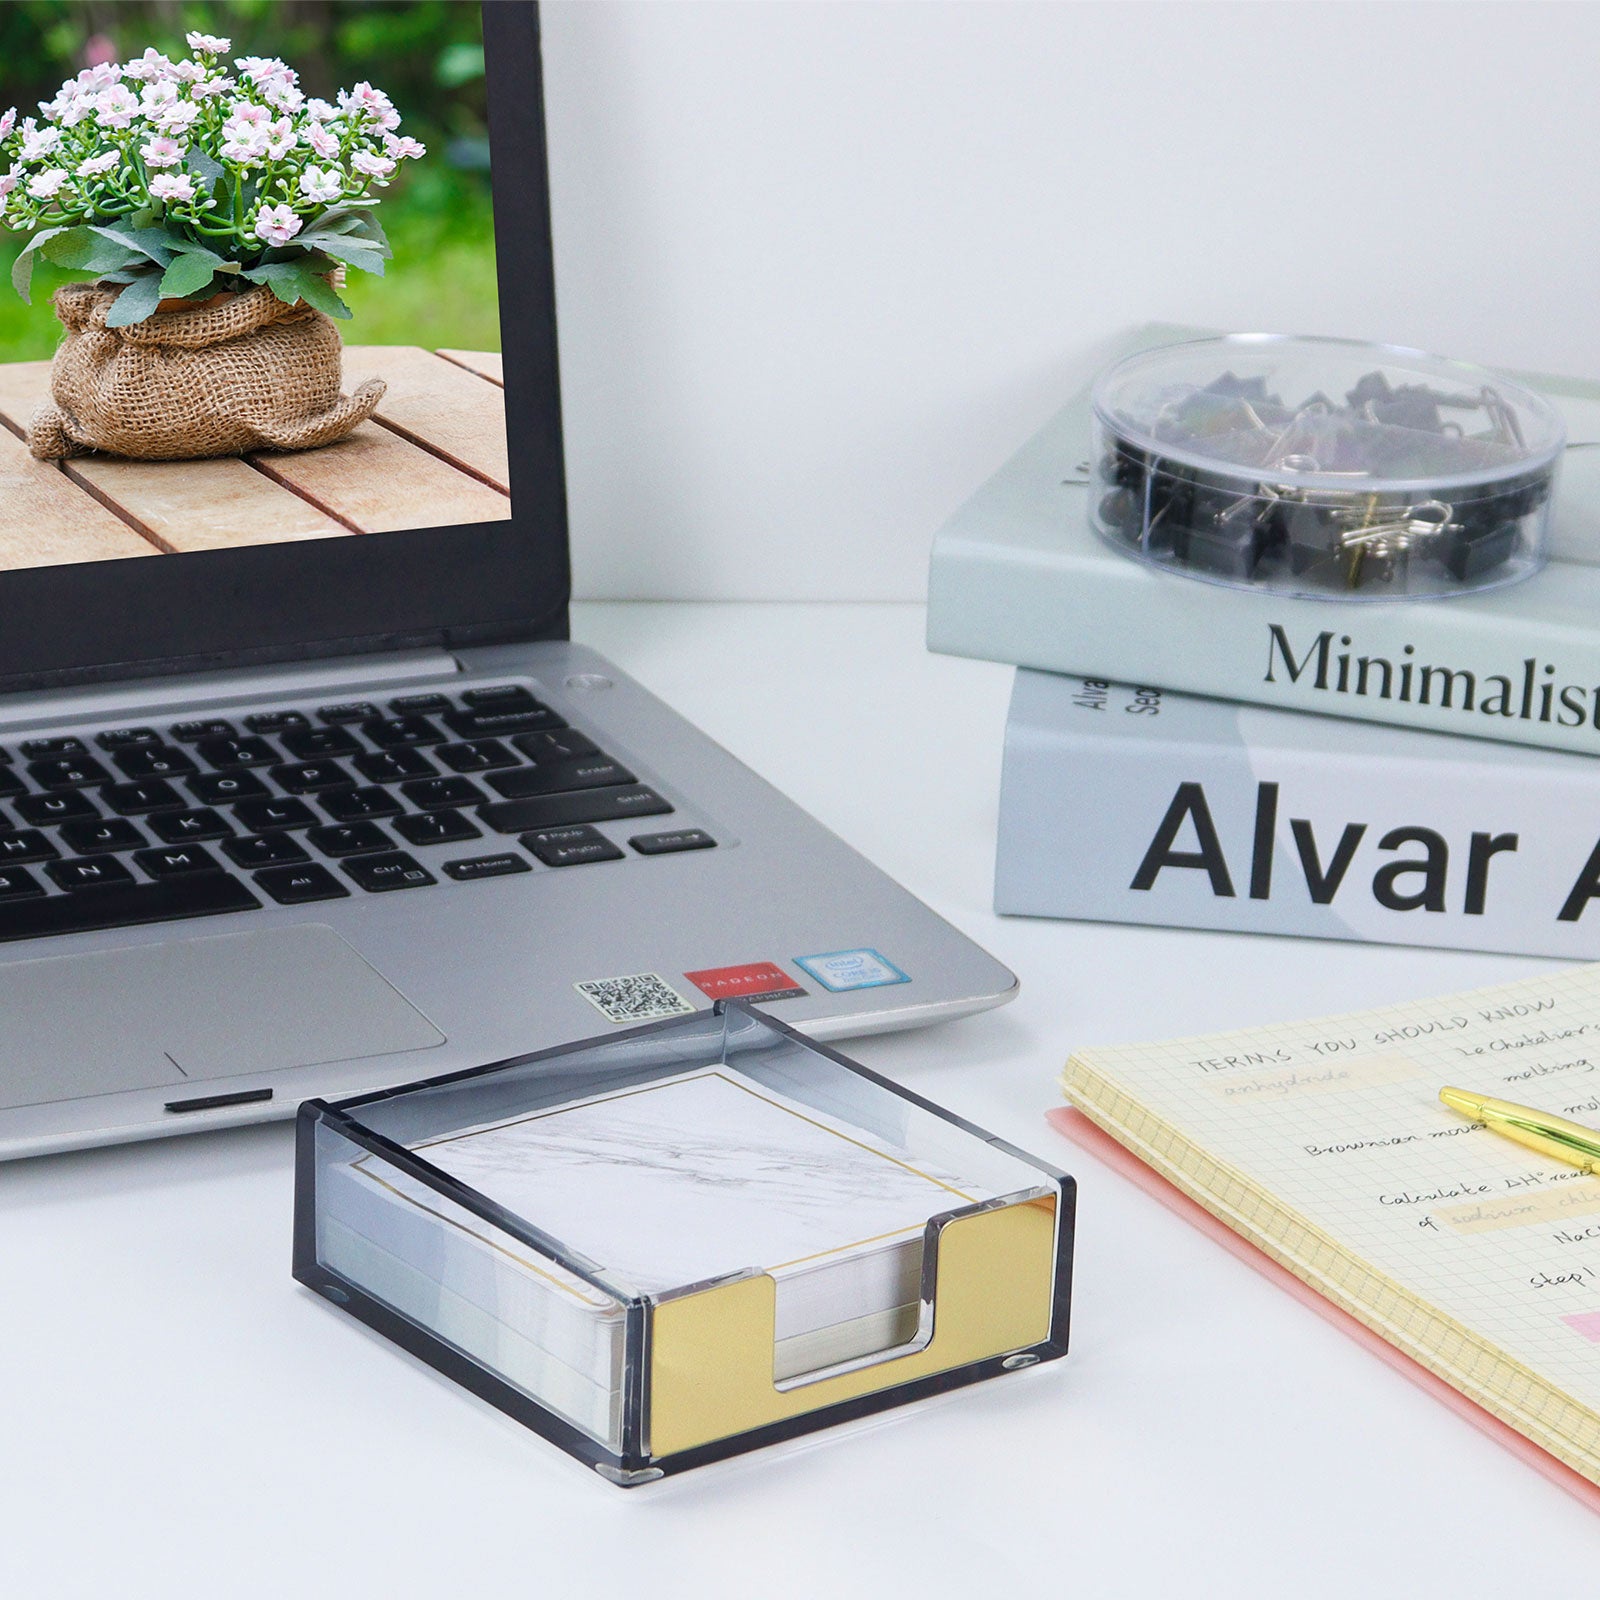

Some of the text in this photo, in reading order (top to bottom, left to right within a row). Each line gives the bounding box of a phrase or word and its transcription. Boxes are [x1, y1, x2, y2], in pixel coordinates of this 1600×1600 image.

[302, 769, 319, 779] P
[576, 765, 614, 776] Enter
[616, 793, 652, 803] Shift
[45, 800, 66, 810] U
[266, 808, 286, 817] L
[179, 817, 201, 829] K
[97, 828, 112, 838] J
[3, 839, 26, 851] H
[657, 836, 682, 844] End
[1130, 781, 1519, 915] Alvar
[165, 854, 190, 865] M
[475, 859, 512, 869] Home
[77, 865, 101, 876] N
[373, 864, 402, 875] Ctrl
[702, 972, 783, 988] RADEON
[1189, 998, 1555, 1073] TERMS YOU SHOULD KNOW
[1503, 1058, 1595, 1082] melting
[1224, 1070, 1351, 1096] anhydride
[1303, 1135, 1422, 1157] Brownian
[1380, 1183, 1492, 1206] Calculate
[1418, 1216, 1439, 1231] of
[1452, 1206, 1537, 1225] sodium
